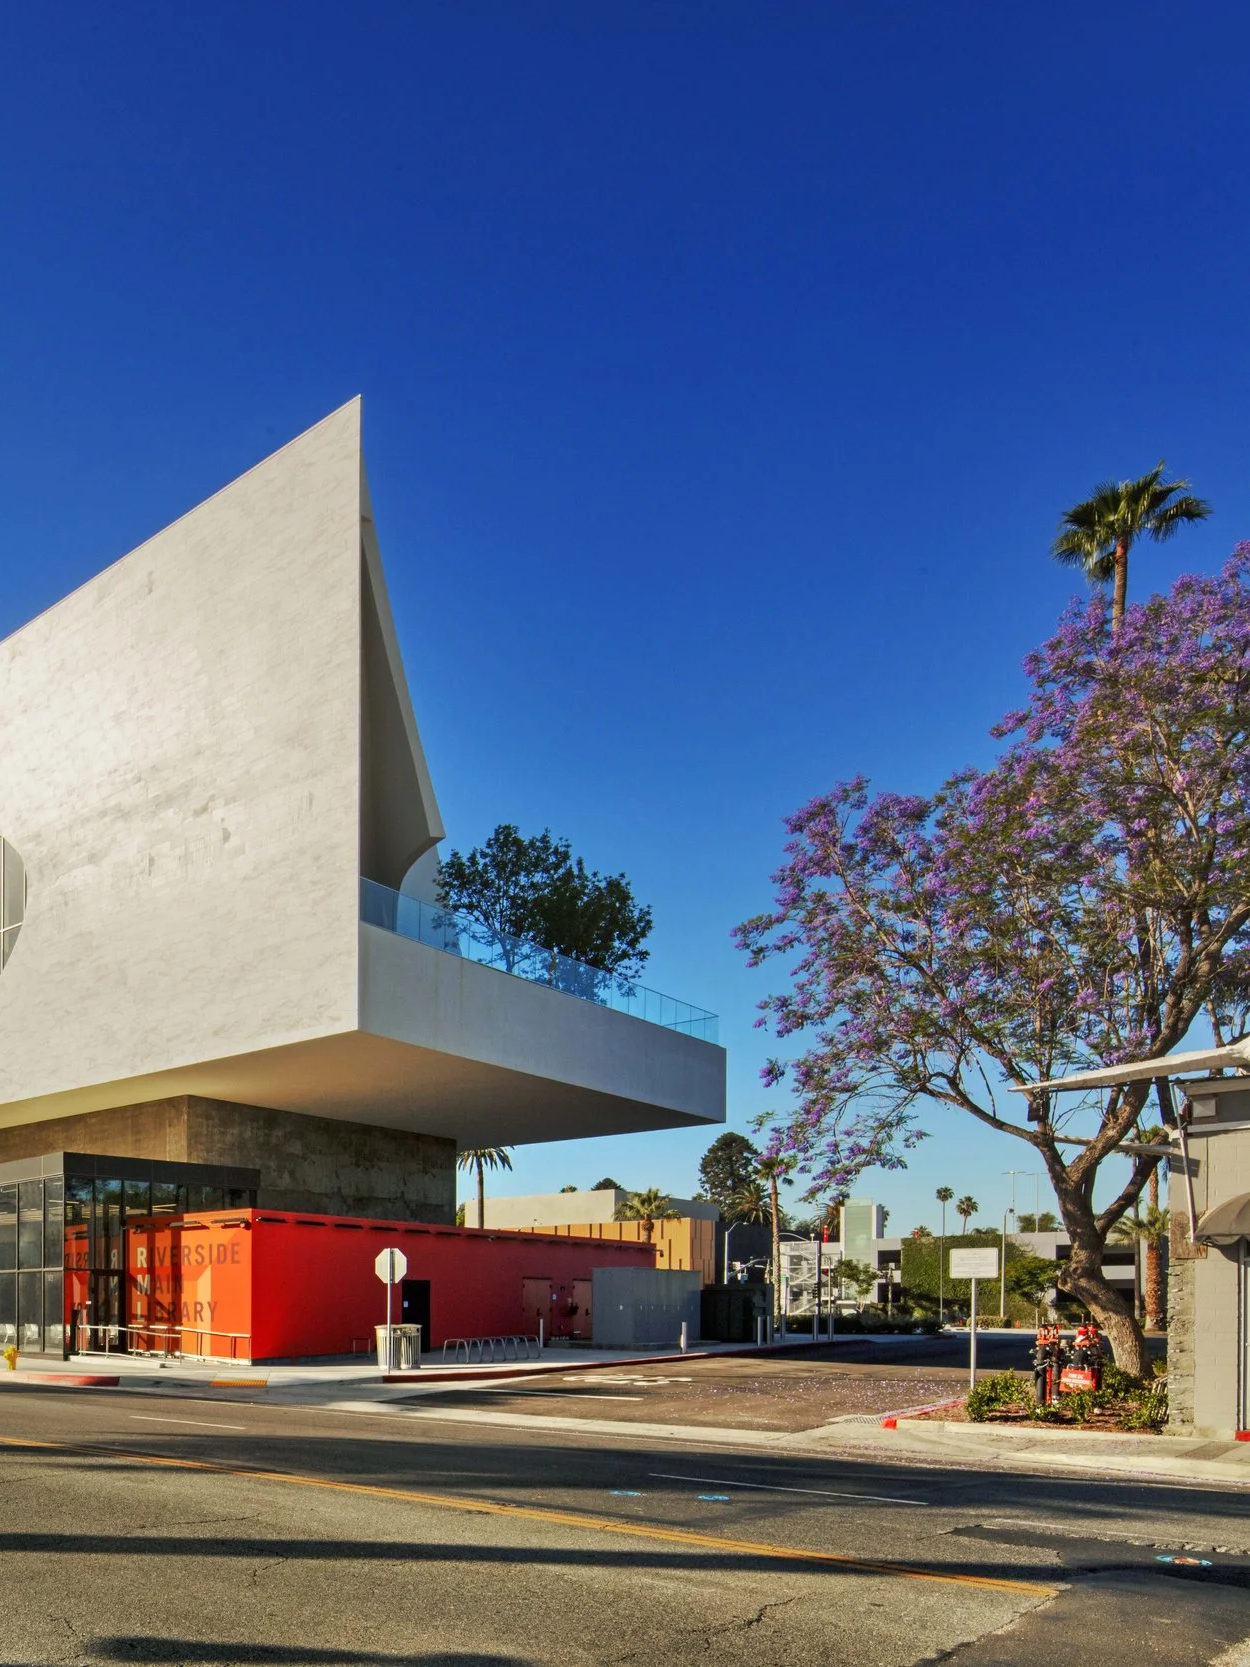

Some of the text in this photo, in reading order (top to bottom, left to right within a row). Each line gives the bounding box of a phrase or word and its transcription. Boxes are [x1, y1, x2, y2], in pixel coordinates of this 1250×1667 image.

[136, 1243, 241, 1268] RIVERSIDE
[136, 1273, 185, 1295] MAIN
[136, 1300, 219, 1323] LIBRARY
